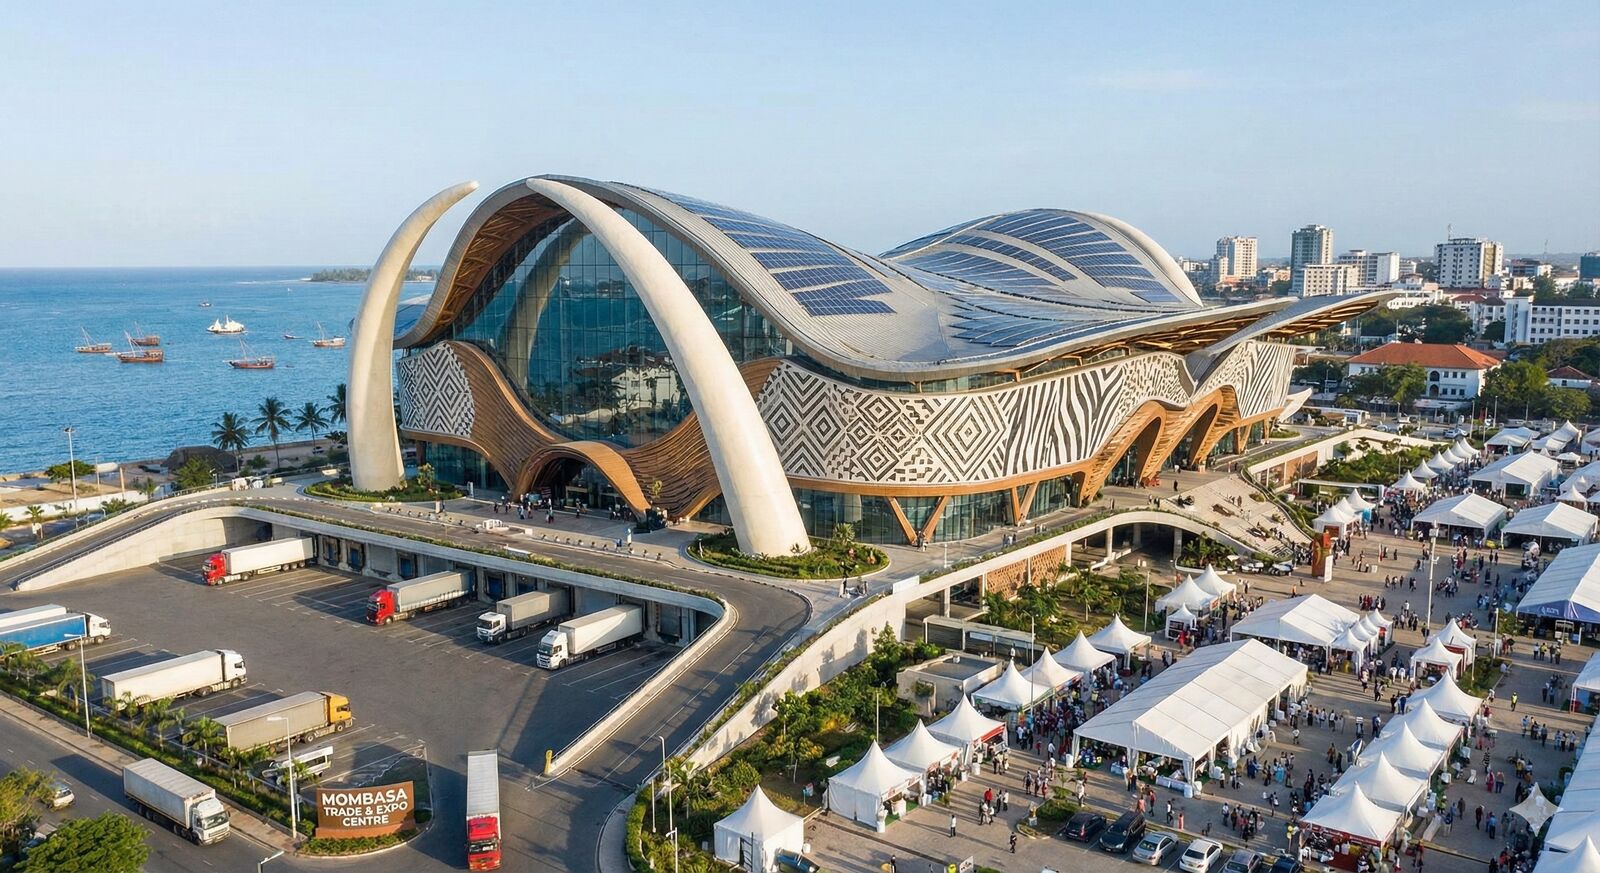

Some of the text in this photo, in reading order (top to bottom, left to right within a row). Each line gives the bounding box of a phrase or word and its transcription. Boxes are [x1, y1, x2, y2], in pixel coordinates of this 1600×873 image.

[322, 788, 408, 806] MOMBASA
[324, 801, 408, 816] TRADE & EXPO
[343, 815, 389, 826] CENTRE
